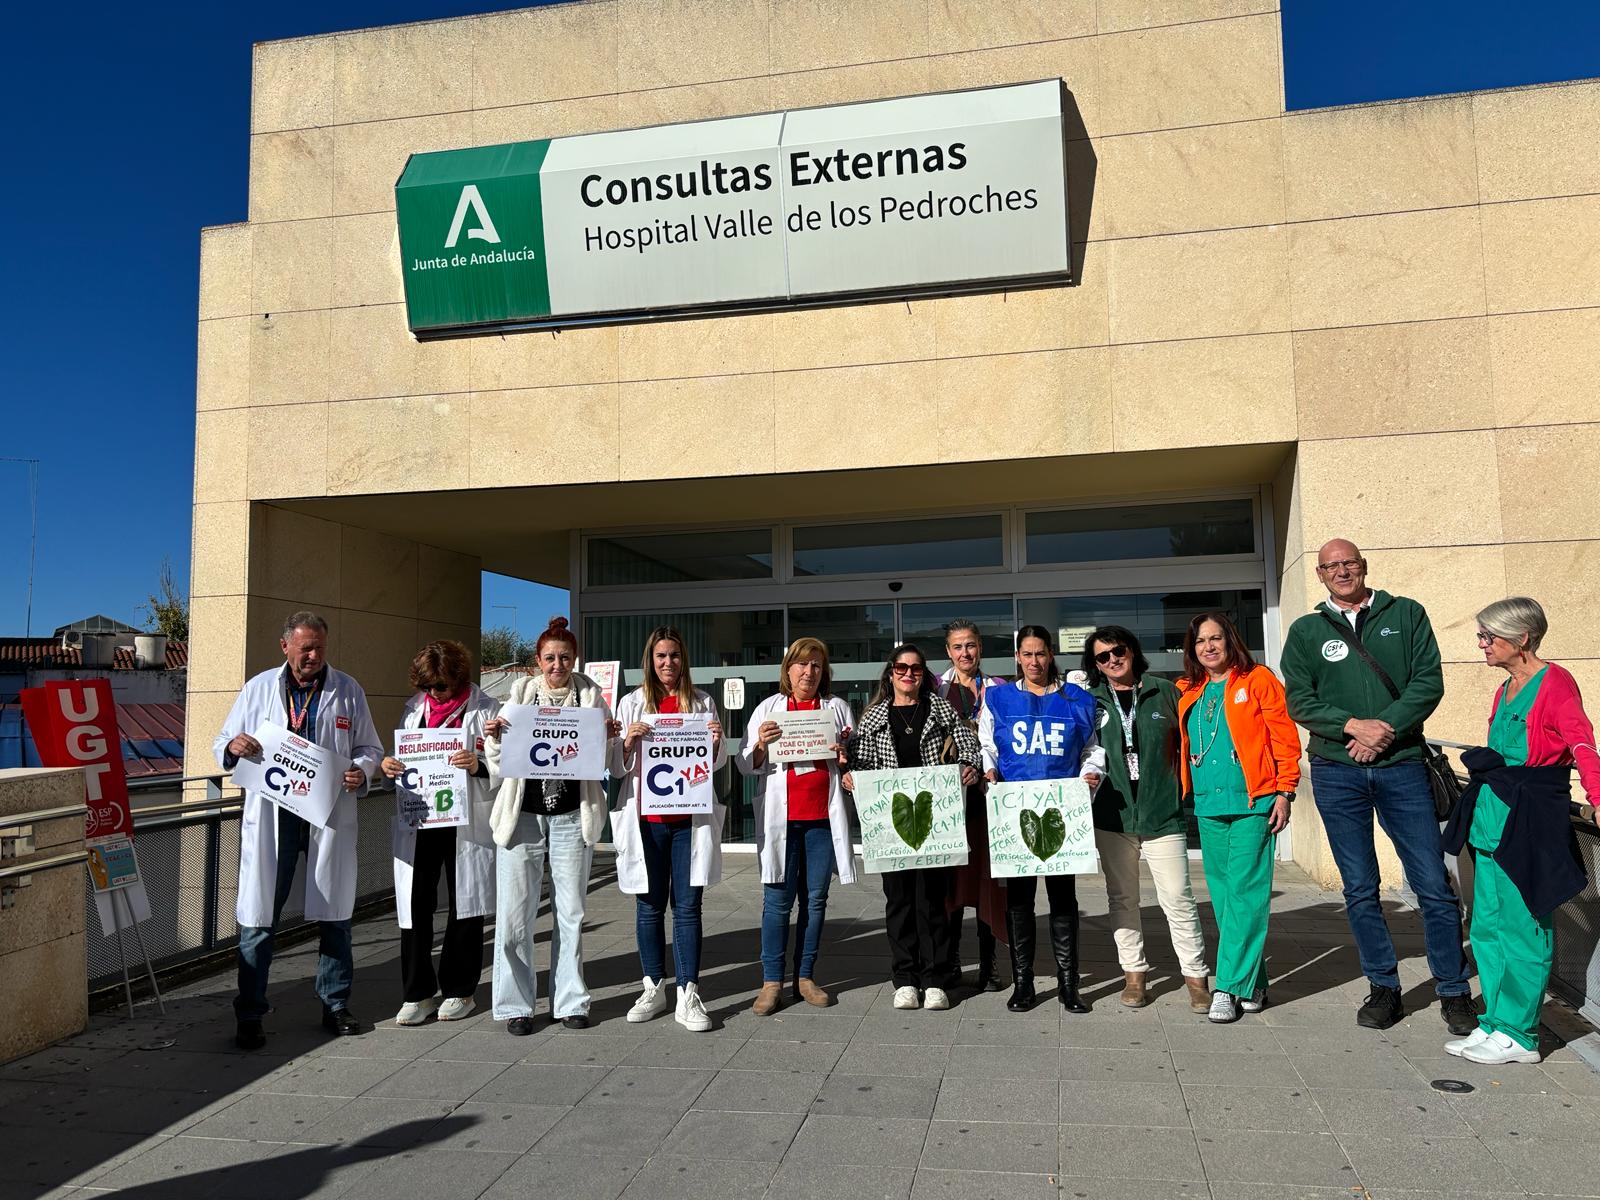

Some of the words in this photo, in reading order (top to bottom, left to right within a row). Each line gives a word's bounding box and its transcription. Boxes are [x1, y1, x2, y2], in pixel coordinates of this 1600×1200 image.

[580, 160, 773, 208] Consultas
[790, 142, 967, 187] Externas
[585, 214, 698, 254] Hospital
[704, 209, 773, 240] Valle
[787, 204, 822, 233] de
[830, 201, 871, 229] los
[880, 185, 1038, 223] Pedroches
[412, 257, 448, 271] Junta
[451, 254, 467, 267] de
[470, 246, 535, 266] Andalucía
[58, 687, 111, 802] UGT
[532, 729, 579, 739] GRUPO
[398, 738, 463, 755] RECLASIFICACIÓN
[529, 742, 558, 767] C1
[556, 742, 579, 757] YA!
[648, 745, 708, 759] GRUPO
[273, 753, 316, 779] GRUPO
[264, 766, 291, 796] C1
[290, 779, 311, 792] YA!
[401, 767, 423, 790] C1
[646, 763, 684, 797] C1
[680, 761, 710, 781] YA!
[873, 778, 909, 794] TCAE
[942, 774, 960, 790] YA!
[434, 788, 454, 812] B
[934, 790, 961, 812] TCAE
[992, 792, 1025, 816] ¡C1
[1033, 784, 1064, 808] YA!
[99, 807, 113, 817] ESP
[1065, 802, 1091, 822] TCAE
[863, 822, 886, 843] TCAE
[990, 822, 1012, 839] TCAE
[1066, 820, 1092, 845] TCAE
[989, 834, 1018, 852] TCAE
[890, 858, 906, 870] 76
[915, 854, 951, 866] EBEP
[1015, 864, 1029, 874] 76
[1035, 861, 1070, 874] EBEP
